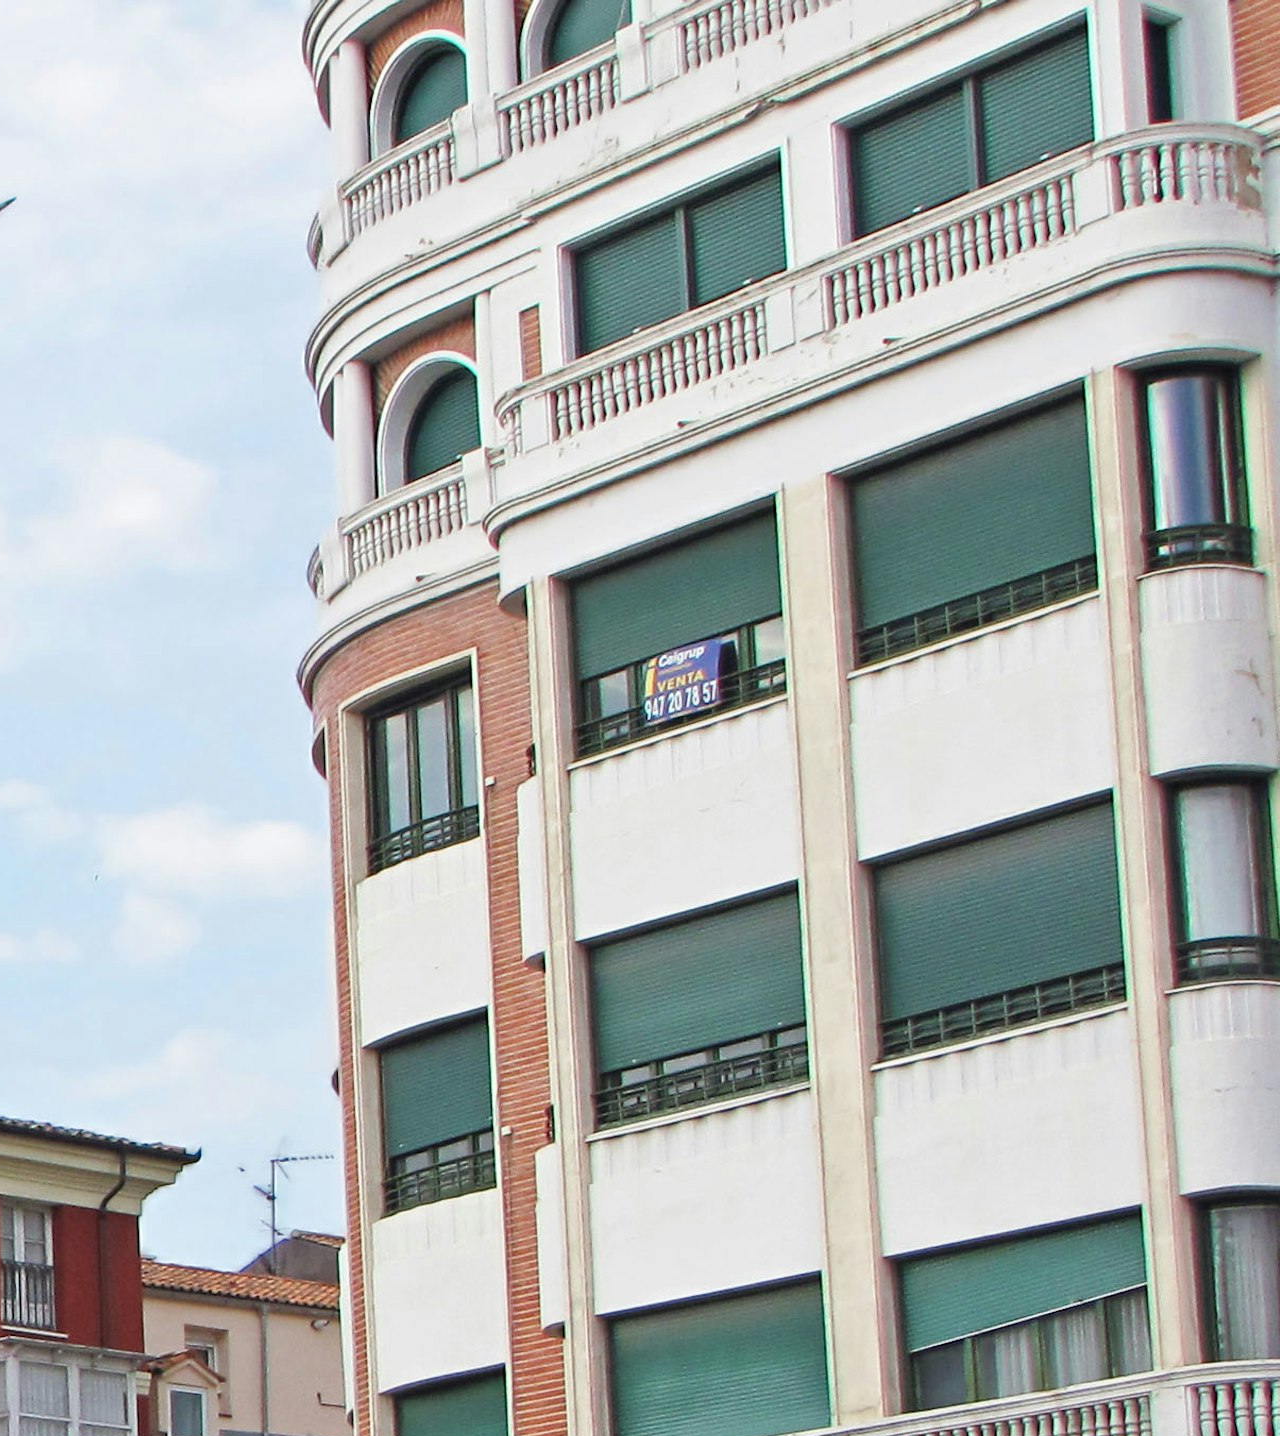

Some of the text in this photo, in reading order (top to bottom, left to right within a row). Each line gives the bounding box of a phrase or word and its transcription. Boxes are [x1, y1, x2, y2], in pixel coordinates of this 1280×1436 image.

[657, 670, 706, 692] VENTA
[644, 679, 717, 721] 947 20 78 57
